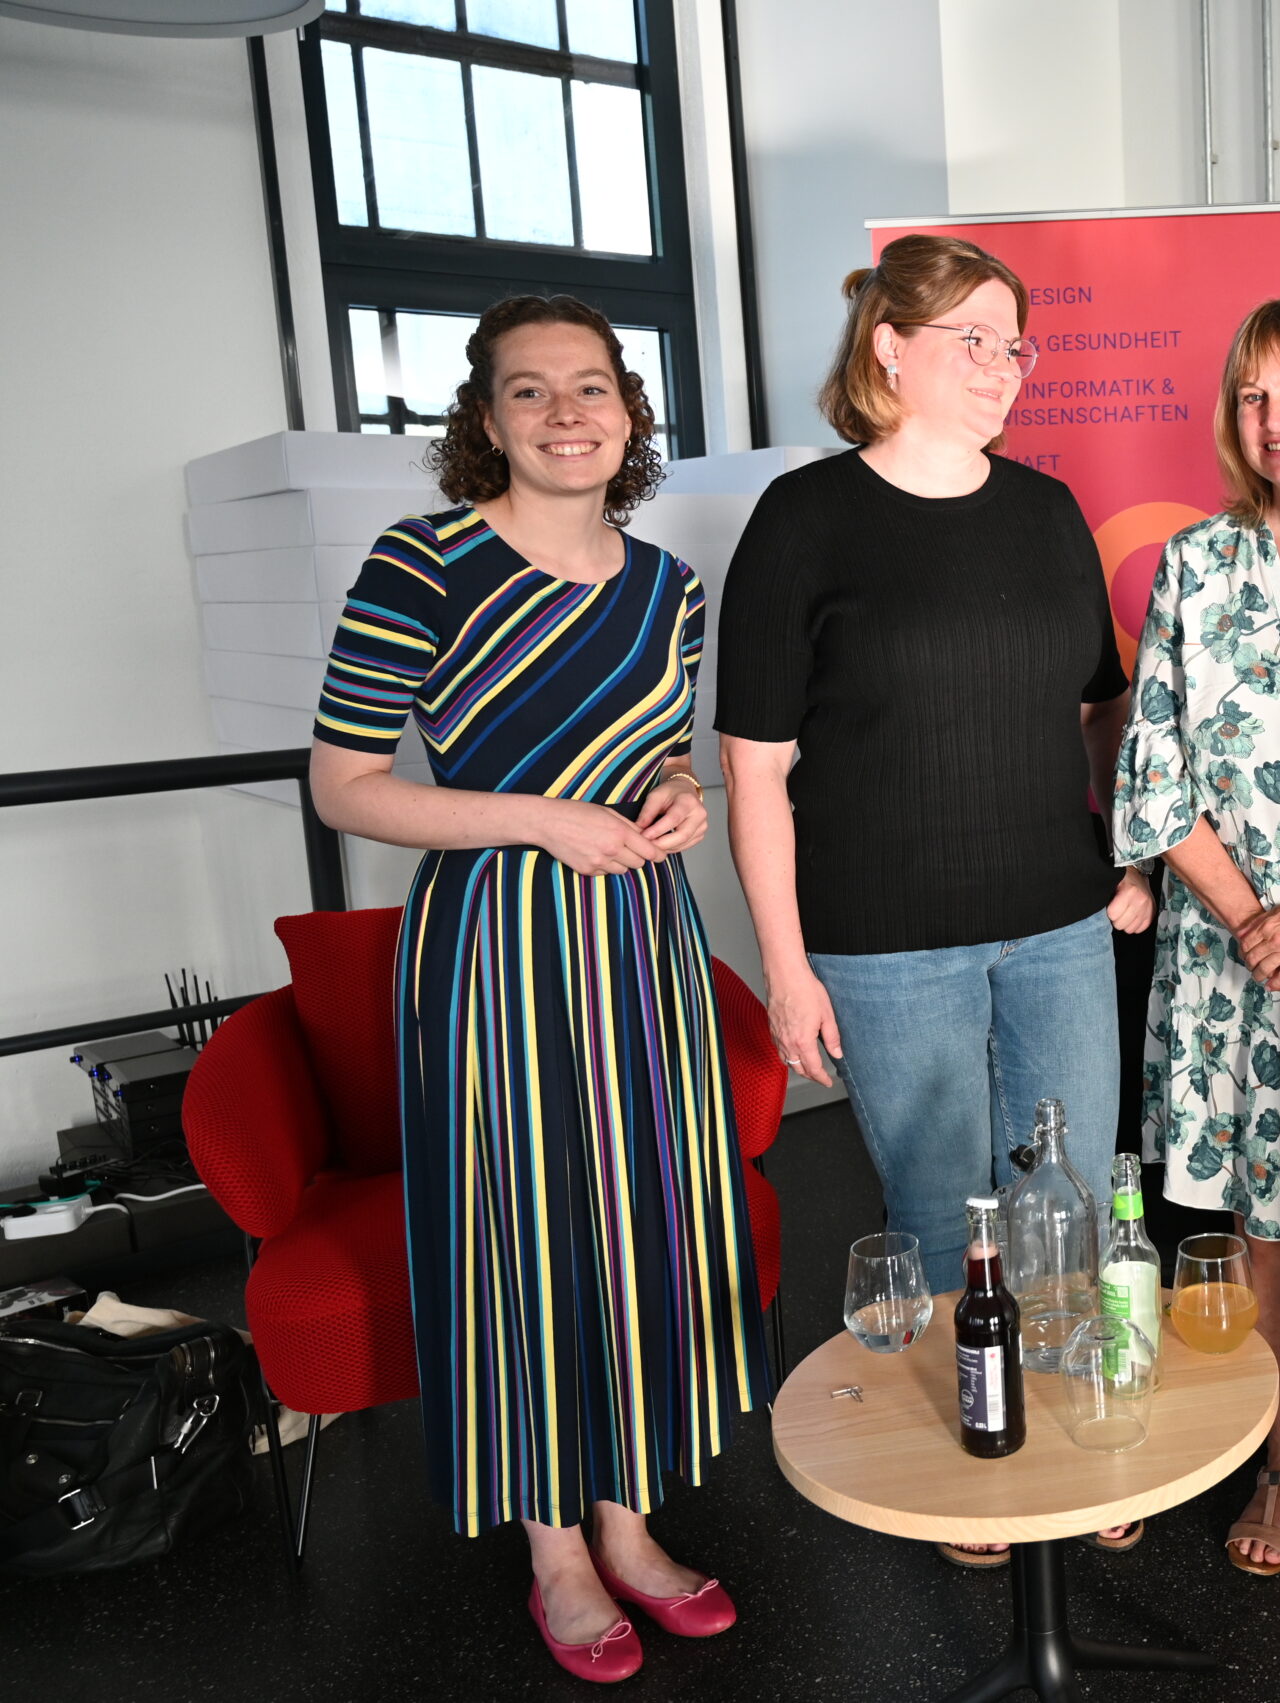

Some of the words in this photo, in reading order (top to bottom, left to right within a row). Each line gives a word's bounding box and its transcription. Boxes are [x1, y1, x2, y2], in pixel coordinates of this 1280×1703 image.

[1030, 286, 1092, 305] ESIGN
[1047, 330, 1182, 352] GESUNDHEIT
[1025, 379, 1155, 400] INFORMATIK
[1162, 377, 1175, 395] &
